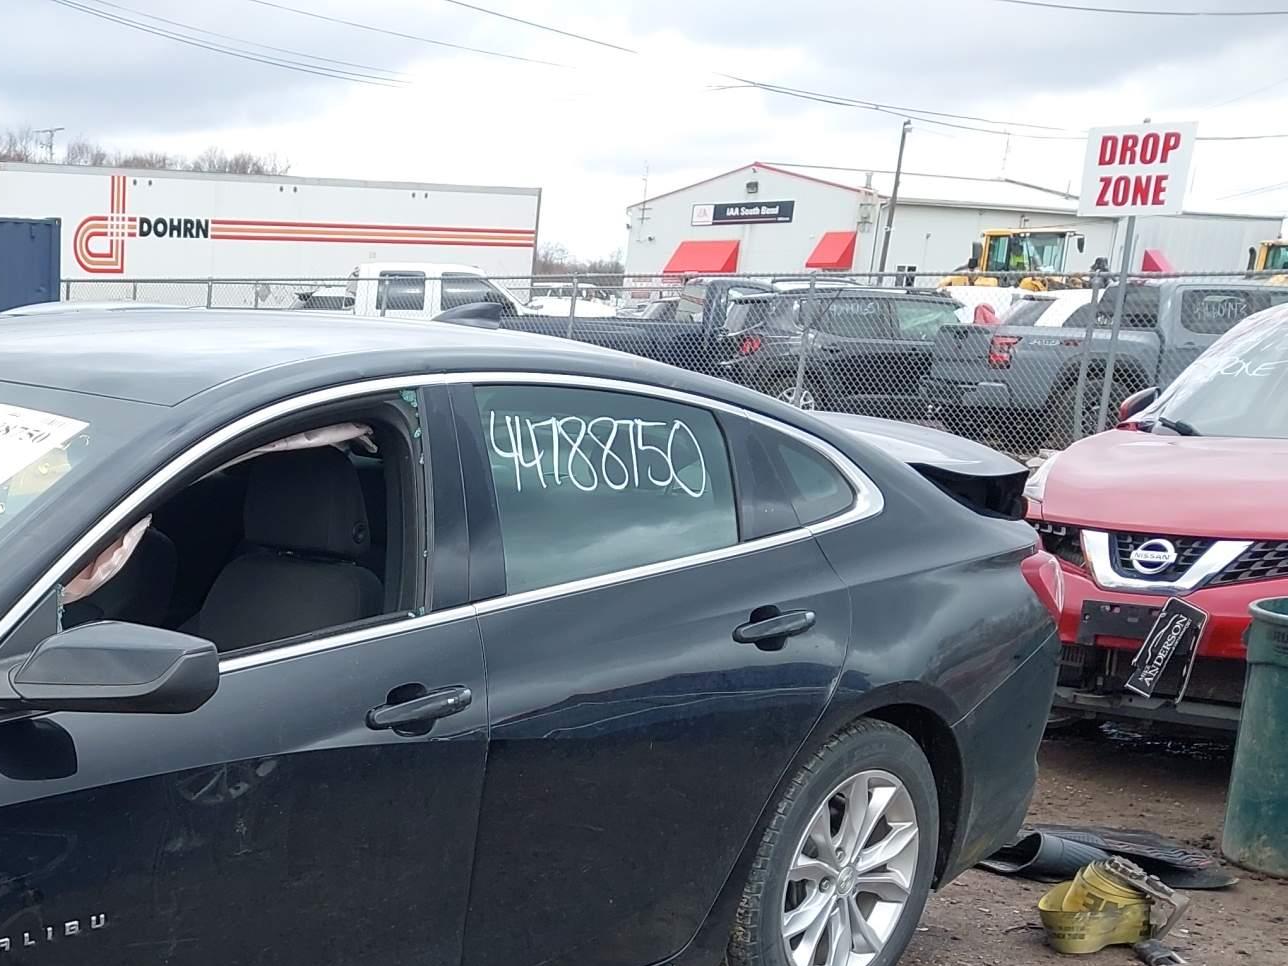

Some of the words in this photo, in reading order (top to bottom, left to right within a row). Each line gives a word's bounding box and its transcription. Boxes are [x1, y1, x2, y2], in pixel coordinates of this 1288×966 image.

[1098, 132, 1181, 166] DROP
[1096, 175, 1169, 206] ZONE
[740, 206, 760, 216] South
[761, 205, 779, 215] Bend
[139, 217, 209, 238] DOHRN
[490, 410, 706, 498] 44788750
[1134, 551, 1171, 560] NISSAN
[1143, 614, 1188, 688] ANDERSON
